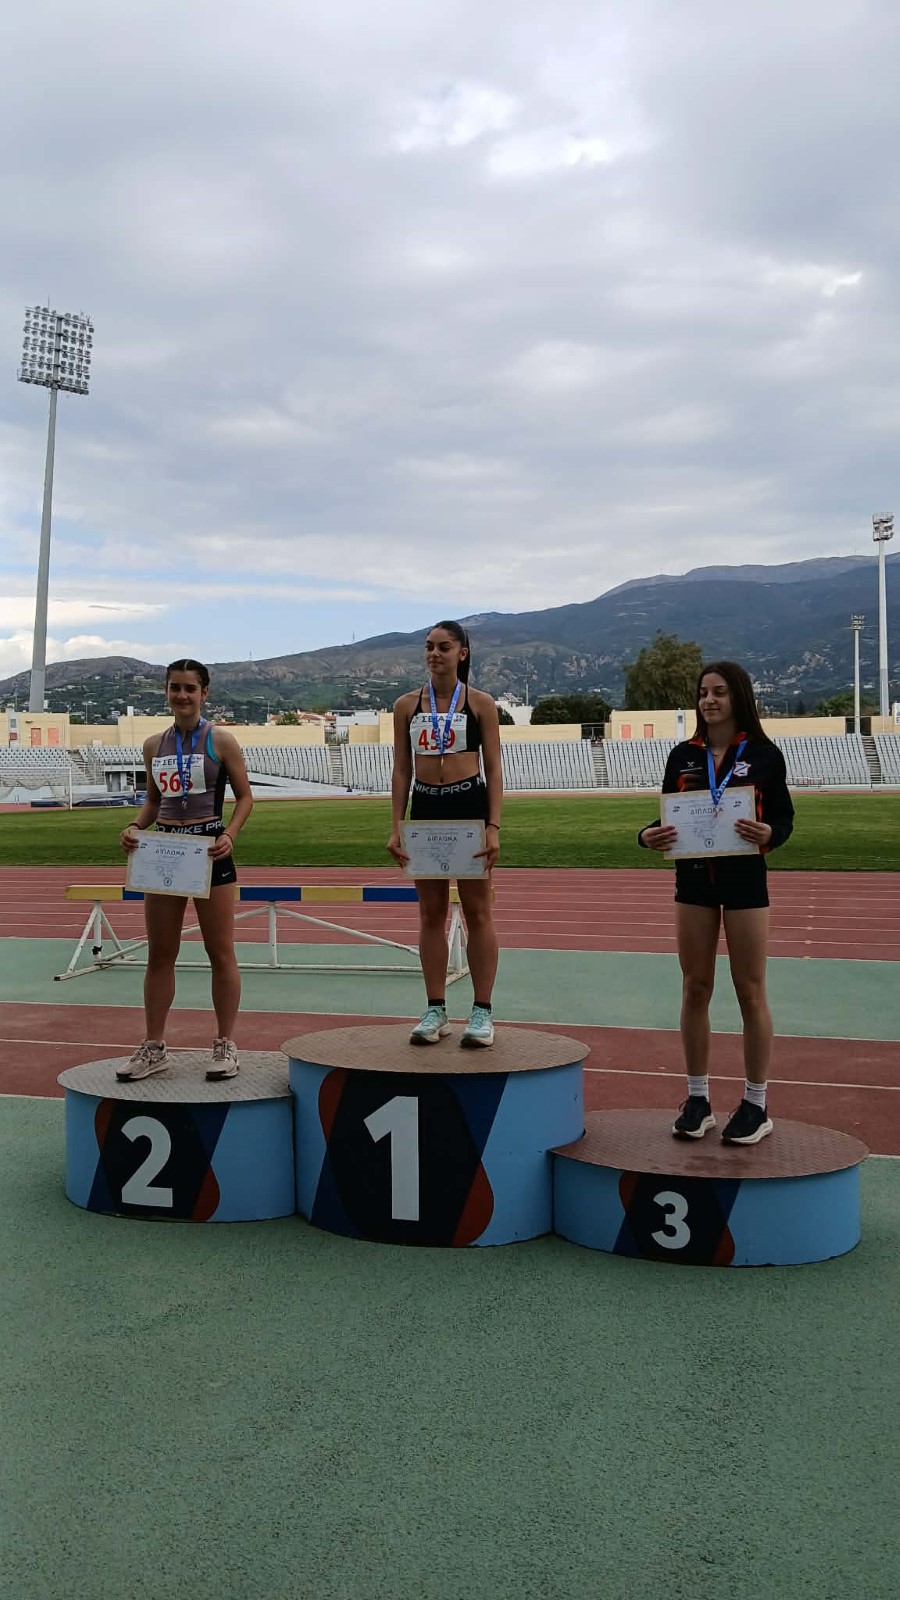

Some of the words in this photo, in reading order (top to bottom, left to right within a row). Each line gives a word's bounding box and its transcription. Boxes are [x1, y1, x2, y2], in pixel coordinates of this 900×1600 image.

[413, 782, 439, 795] NIKE
[440, 781, 472, 795] PRO
[170, 825, 203, 835] NIKE
[121, 1116, 173, 1208] 2
[363, 1096, 420, 1221] 1
[651, 1190, 691, 1250] 3
